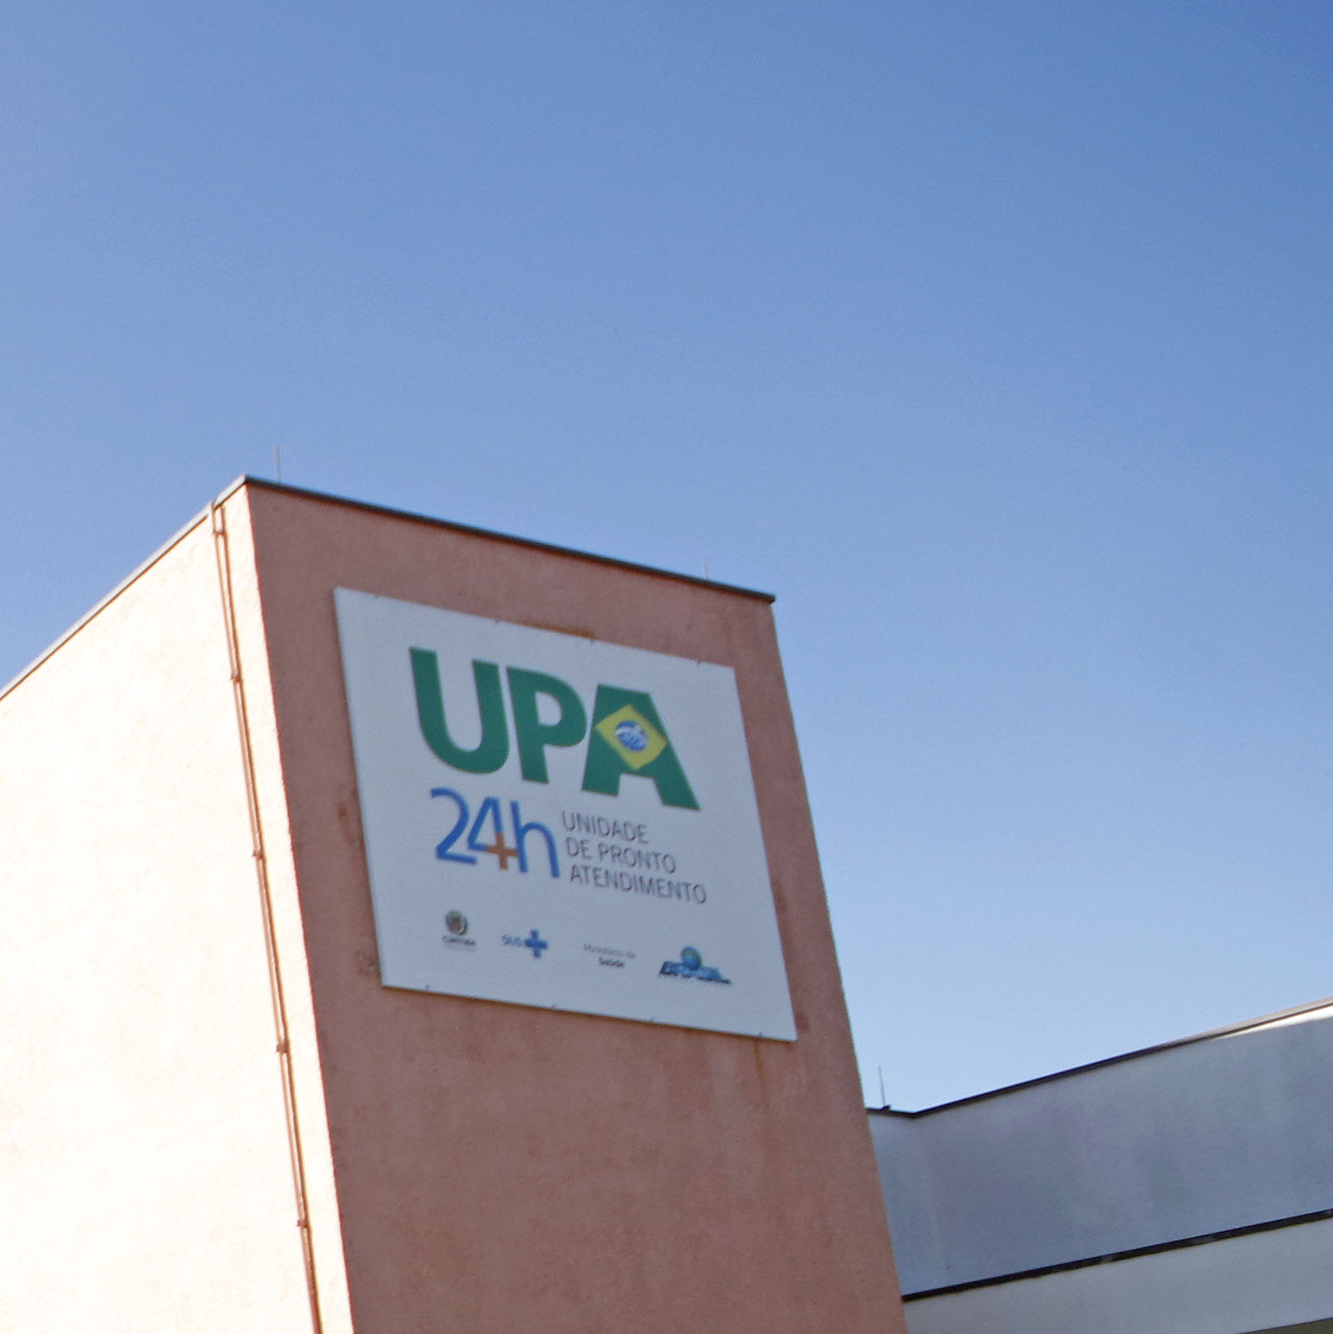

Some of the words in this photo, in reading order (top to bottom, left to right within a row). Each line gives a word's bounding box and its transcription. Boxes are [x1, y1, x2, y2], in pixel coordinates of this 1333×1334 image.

[410, 646, 701, 811] UPA
[430, 788, 560, 879] 24h
[562, 810, 650, 844] UNIDADE
[565, 836, 591, 860] DE
[598, 842, 676, 874] PRONTO
[569, 863, 707, 904] ATENDIMENTO
